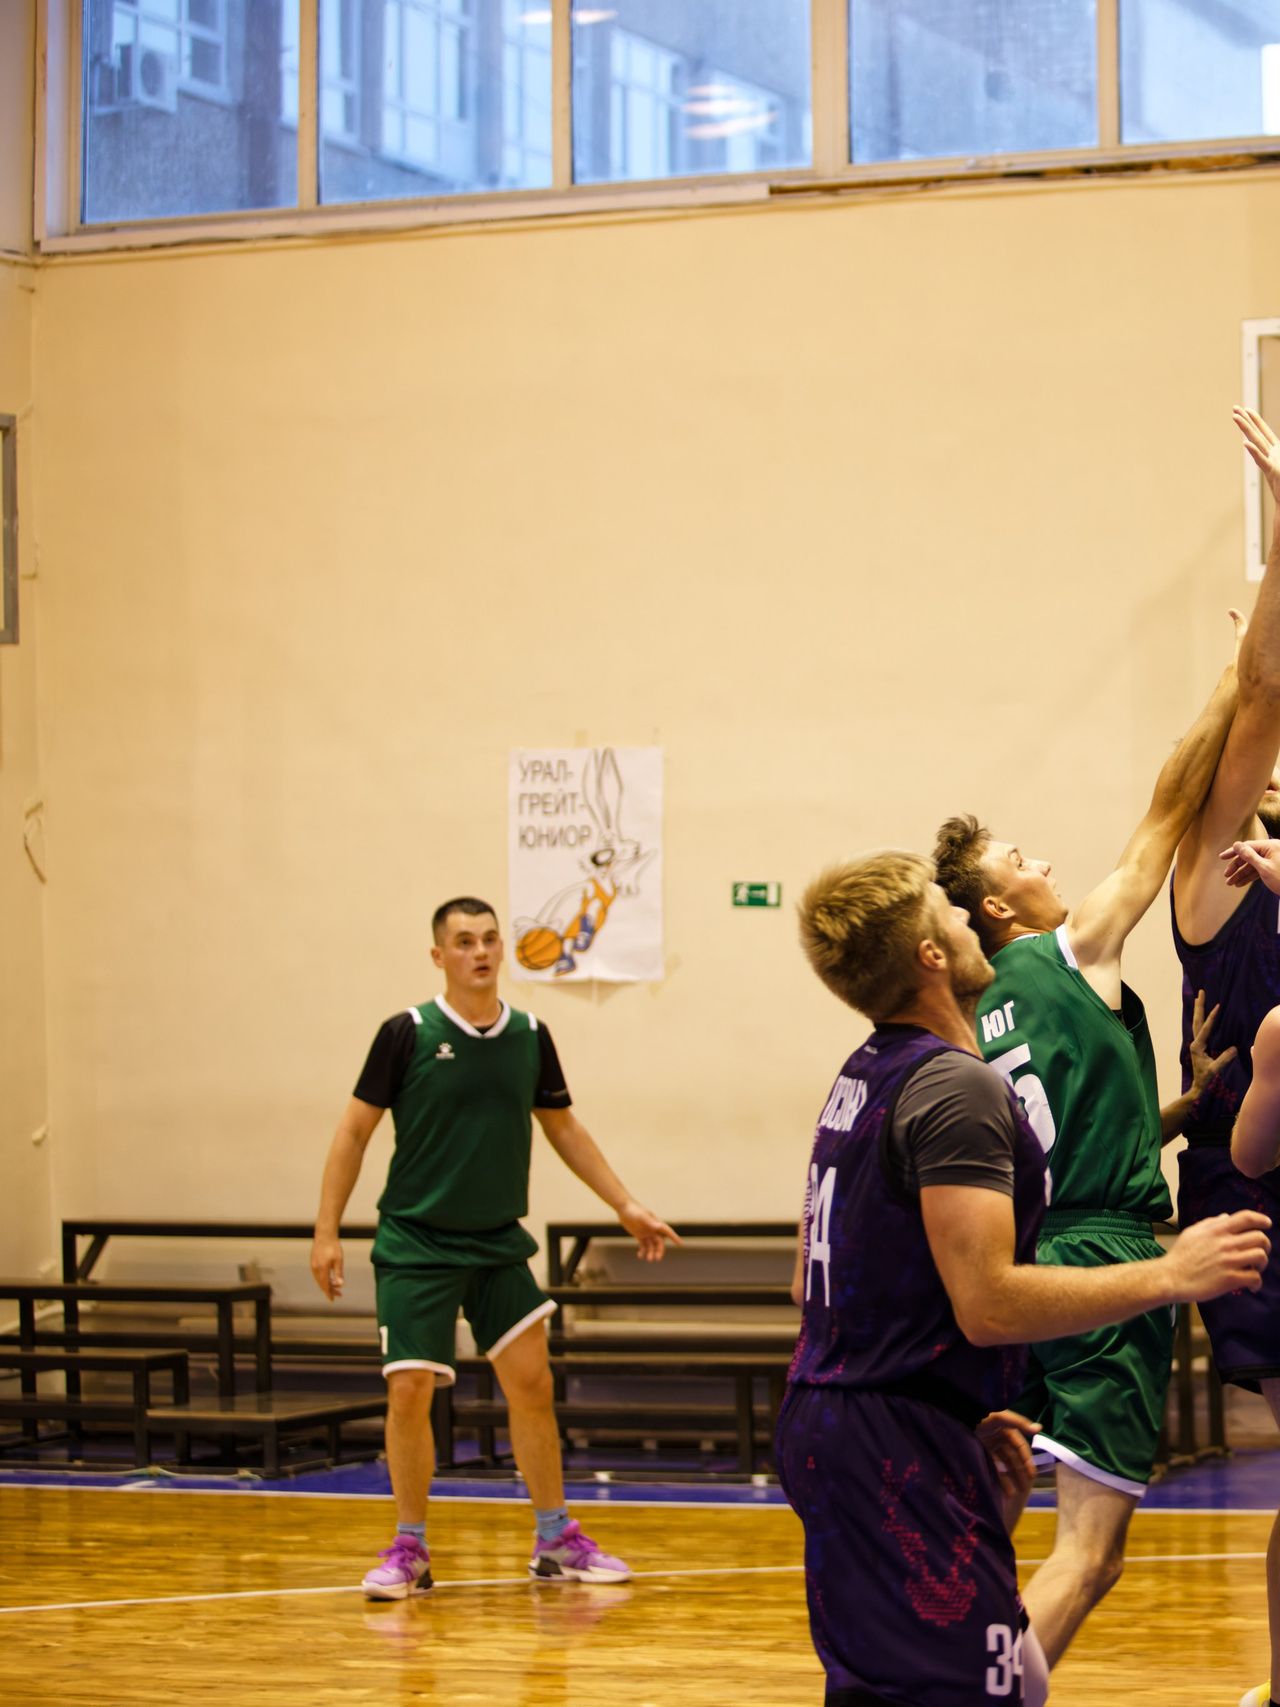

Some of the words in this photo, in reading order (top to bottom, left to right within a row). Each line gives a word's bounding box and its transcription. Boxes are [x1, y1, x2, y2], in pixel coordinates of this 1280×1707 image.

[519, 760, 573, 782] УРАЛ-
[518, 789, 586, 815] ГРЕЙТ-
[519, 825, 592, 850] ЮНИОР
[981, 1000, 1015, 1043] ЮГ
